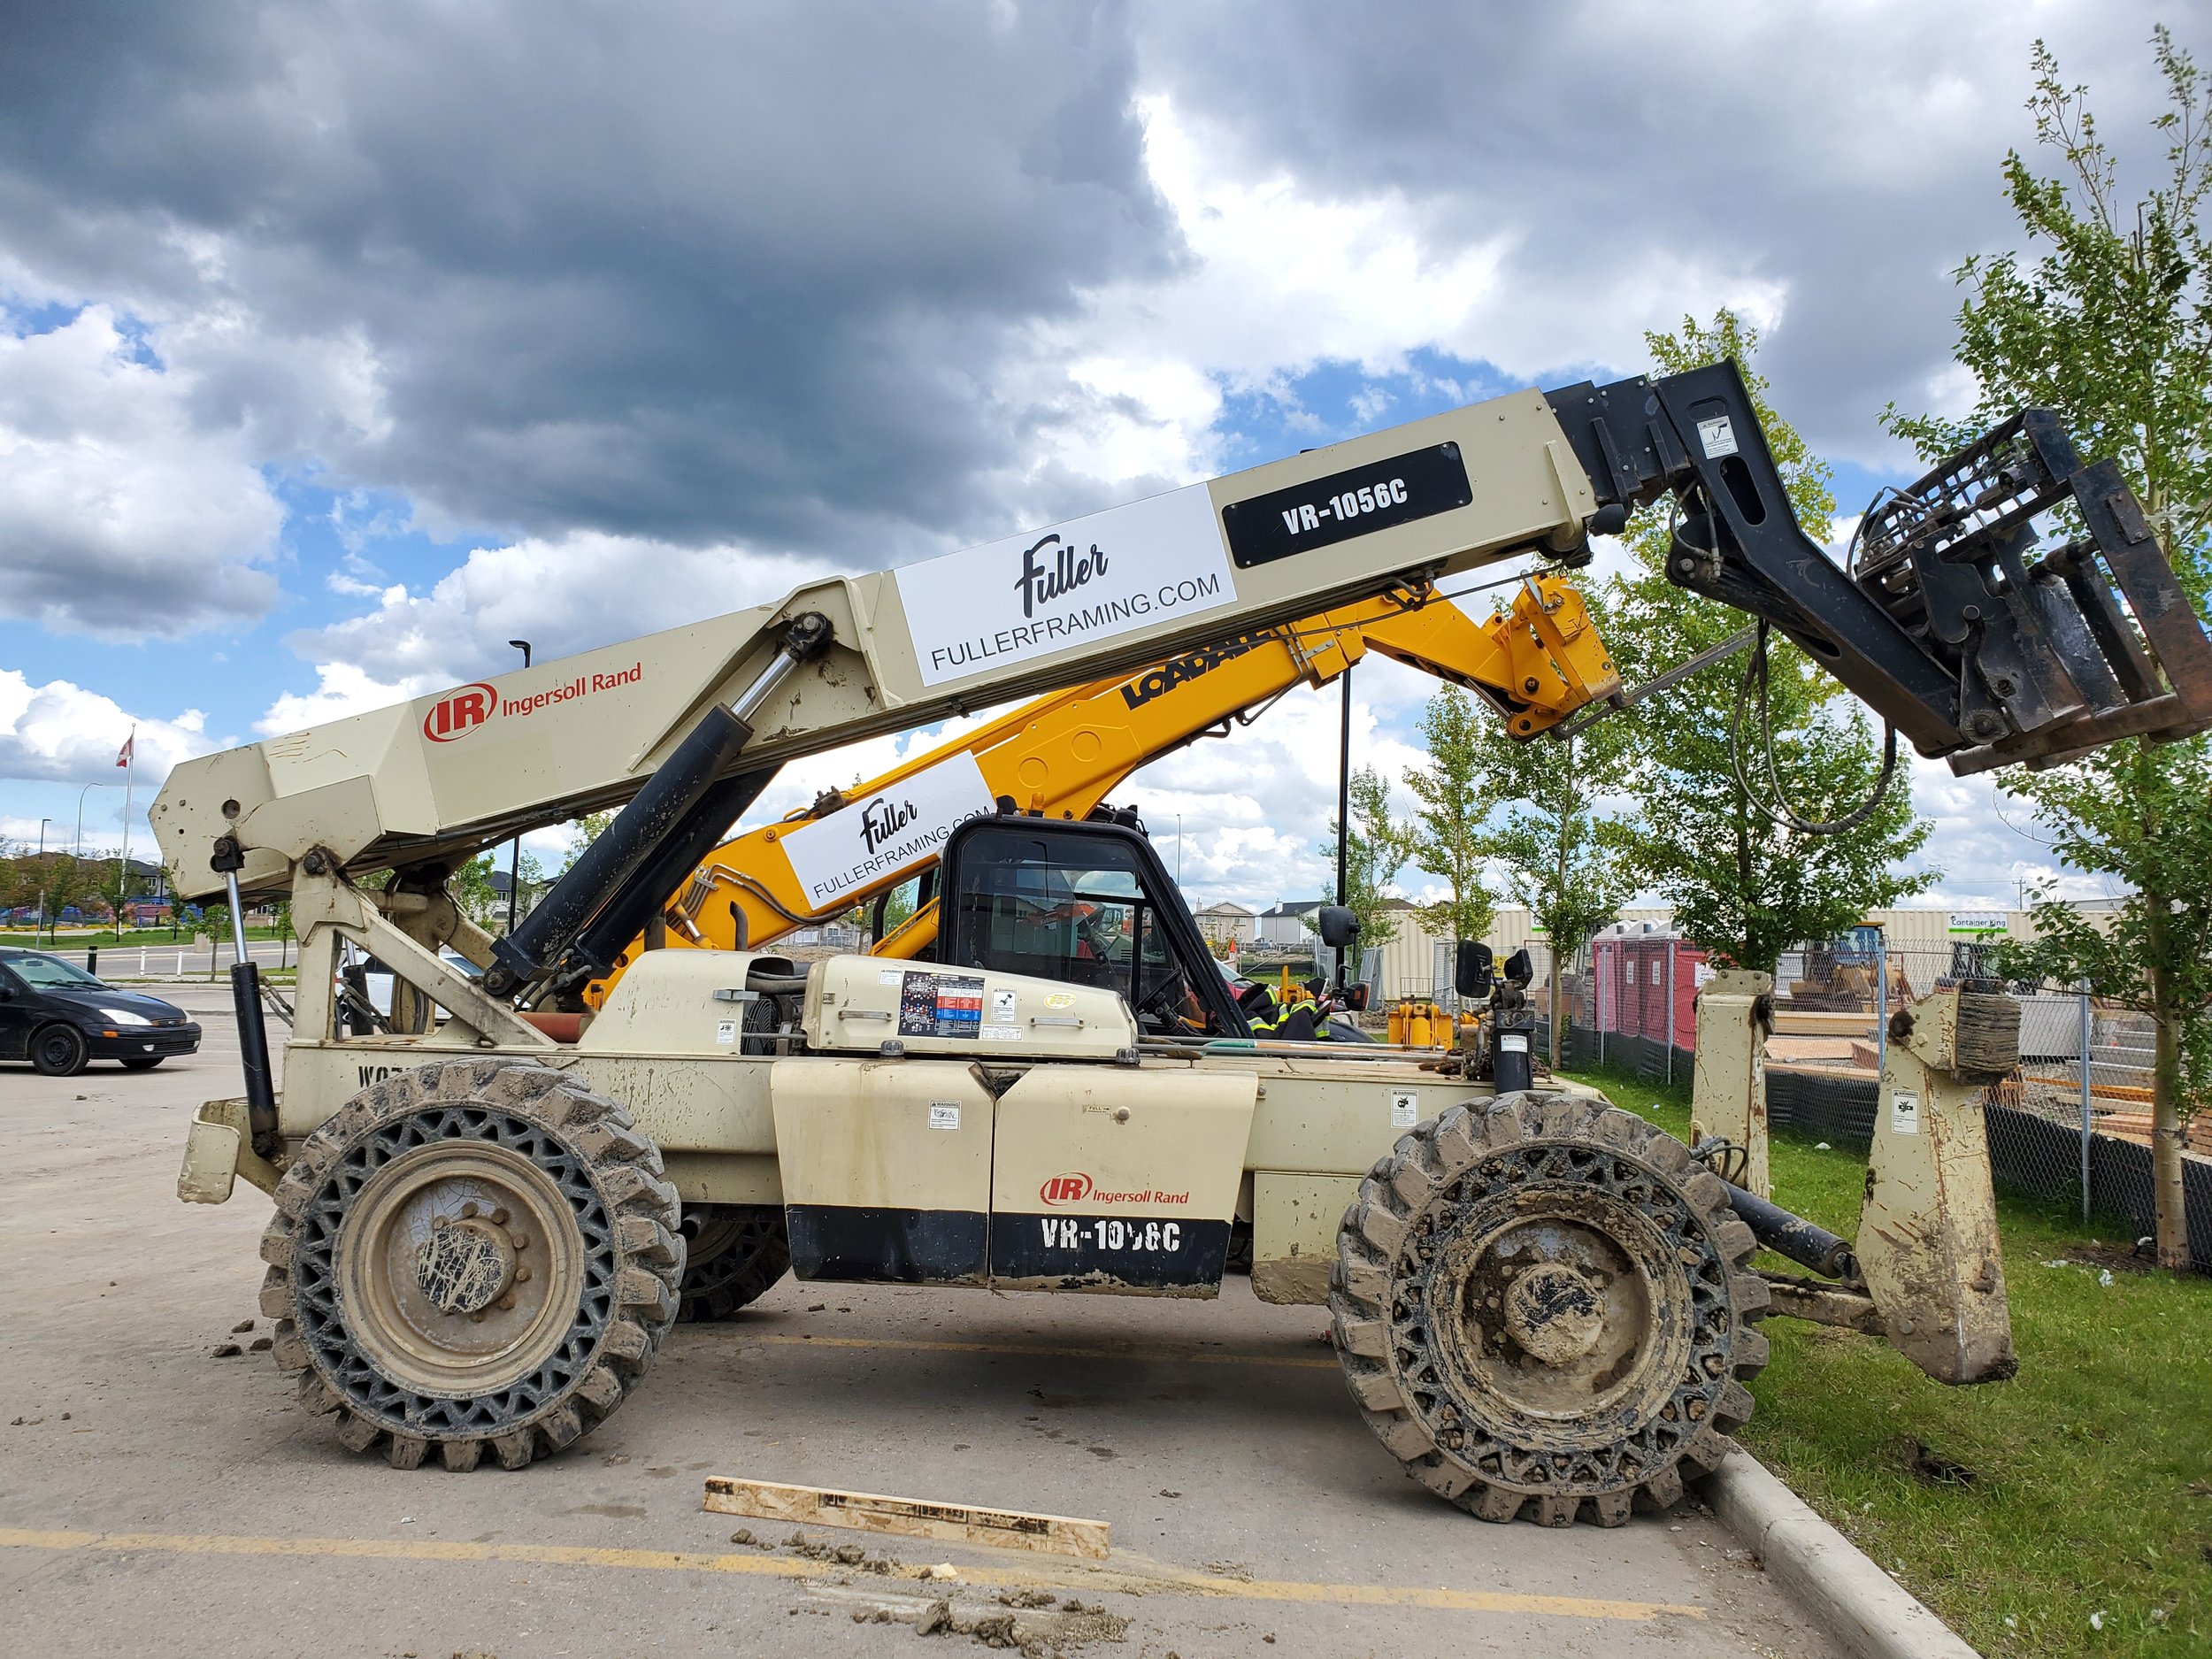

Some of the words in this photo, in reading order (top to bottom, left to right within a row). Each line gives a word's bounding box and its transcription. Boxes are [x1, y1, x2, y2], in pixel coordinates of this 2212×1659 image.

[1282, 479, 1408, 535] VR-1056C
[1014, 534, 1110, 618] Fuller
[931, 573, 1220, 671] FULLERFRAMING.COM
[503, 677, 586, 717] Ingersoll
[592, 662, 641, 693] Rand
[860, 798, 918, 855] Fuller
[1093, 1189, 1150, 1204] Ingersoll
[1154, 1191, 1189, 1204] Rand
